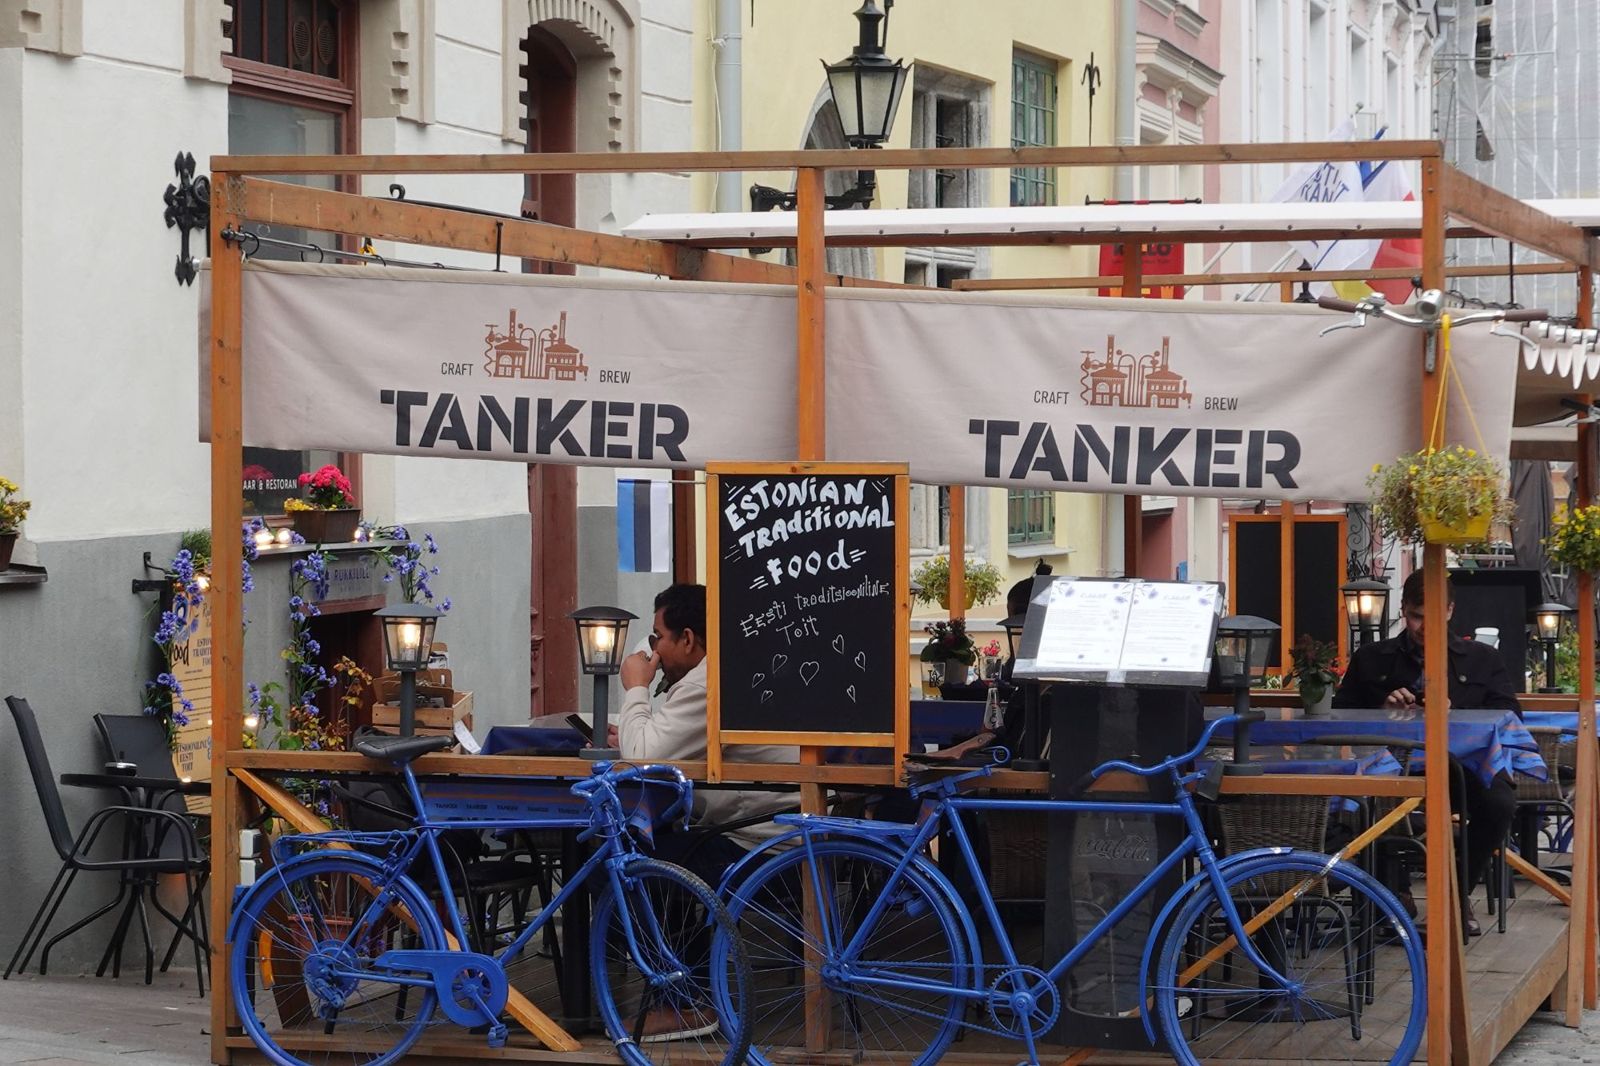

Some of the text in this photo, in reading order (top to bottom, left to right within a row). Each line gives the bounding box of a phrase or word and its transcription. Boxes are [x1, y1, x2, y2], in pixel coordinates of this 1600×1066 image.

[441, 362, 631, 384] CRAFT BREW
[1034, 390, 1239, 411] CRAFT BREW
[380, 389, 690, 462] TANKER
[968, 419, 1302, 489] TANKER
[243, 480, 256, 490] AAR
[265, 479, 298, 490] RESTORAN
